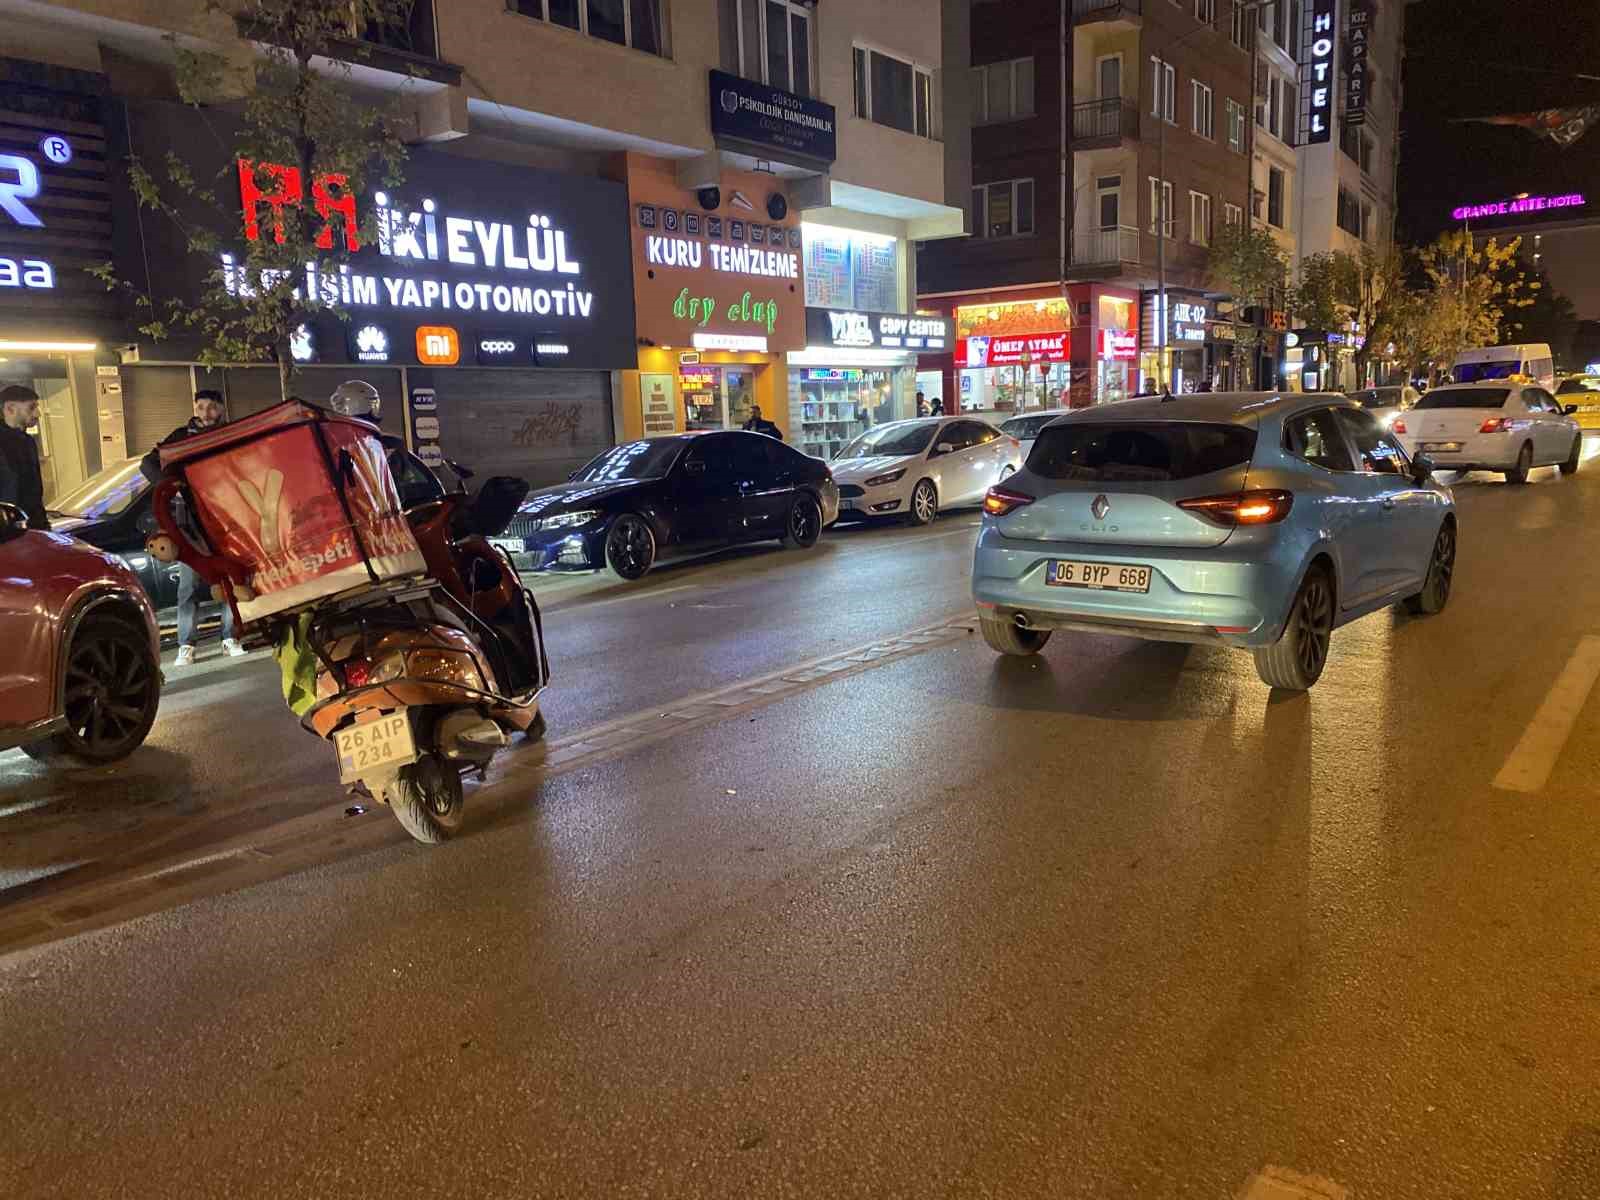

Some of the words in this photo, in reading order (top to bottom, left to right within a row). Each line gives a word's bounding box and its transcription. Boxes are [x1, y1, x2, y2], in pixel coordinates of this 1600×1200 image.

[1312, 12, 1331, 133] HOTEL
[1352, 29, 1364, 107] APART
[739, 96, 783, 119] PSİKOLOJİK
[1548, 195, 1585, 208] HOTEL
[375, 191, 439, 260] İKİ
[446, 214, 580, 274] EYLÜL
[648, 236, 702, 268] KURU
[710, 243, 798, 279] TEMİZLEME
[383, 277, 450, 308] YAPI
[454, 282, 593, 317] OTOMOTİV
[673, 287, 716, 327] dry
[880, 317, 908, 335] COPY
[908, 319, 945, 336] CENTER
[358, 352, 388, 360] HUAWEI
[1080, 524, 1119, 532] CLIO
[1057, 563, 1073, 580] 06
[1083, 565, 1110, 583] BYP
[1119, 568, 1147, 586] 668
[342, 730, 364, 752] 26
[372, 718, 404, 743] AIP
[358, 742, 393, 766] 234
